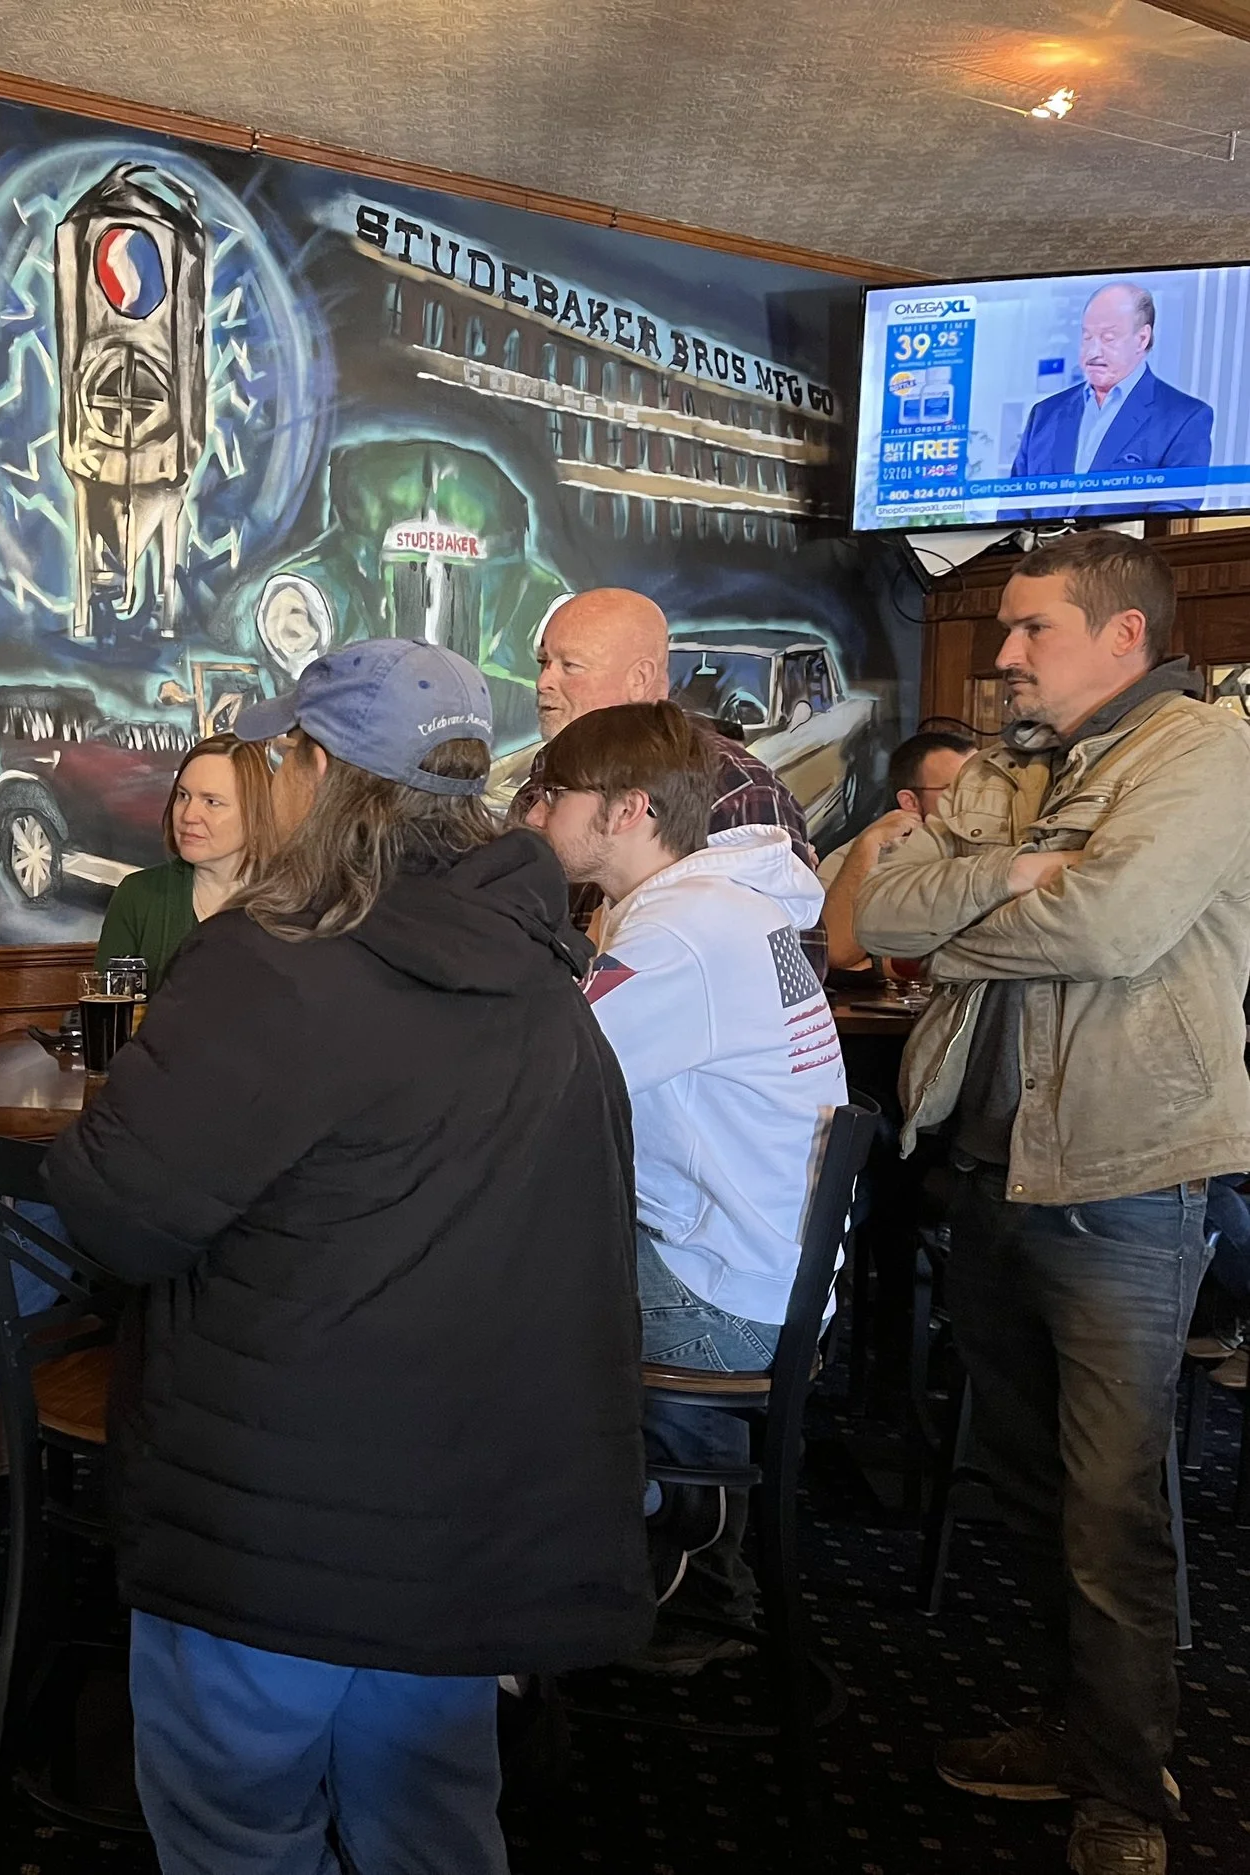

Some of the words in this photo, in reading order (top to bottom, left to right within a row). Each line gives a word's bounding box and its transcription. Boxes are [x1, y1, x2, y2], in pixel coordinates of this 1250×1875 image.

[356, 204, 663, 360] STUDEBAKER
[671, 330, 746, 386] BROS
[754, 360, 802, 407] MFG
[807, 382, 835, 416] CO
[894, 299, 971, 318] OMEGAXL
[892, 324, 938, 334] LIMITED
[944, 321, 969, 330] TIME
[883, 452, 906, 463] GET
[884, 442, 907, 453] BUY
[912, 438, 960, 461] FREE
[970, 484, 992, 495] Get
[993, 482, 1023, 493] back
[1025, 482, 1037, 491] to
[1039, 479, 1058, 490] the
[1059, 477, 1076, 489] life
[1078, 477, 1100, 490] you
[1102, 475, 1130, 487] want
[1132, 474, 1145, 485] to
[1146, 473, 1165, 484] live
[396, 531, 479, 557] STUDEBAKER
